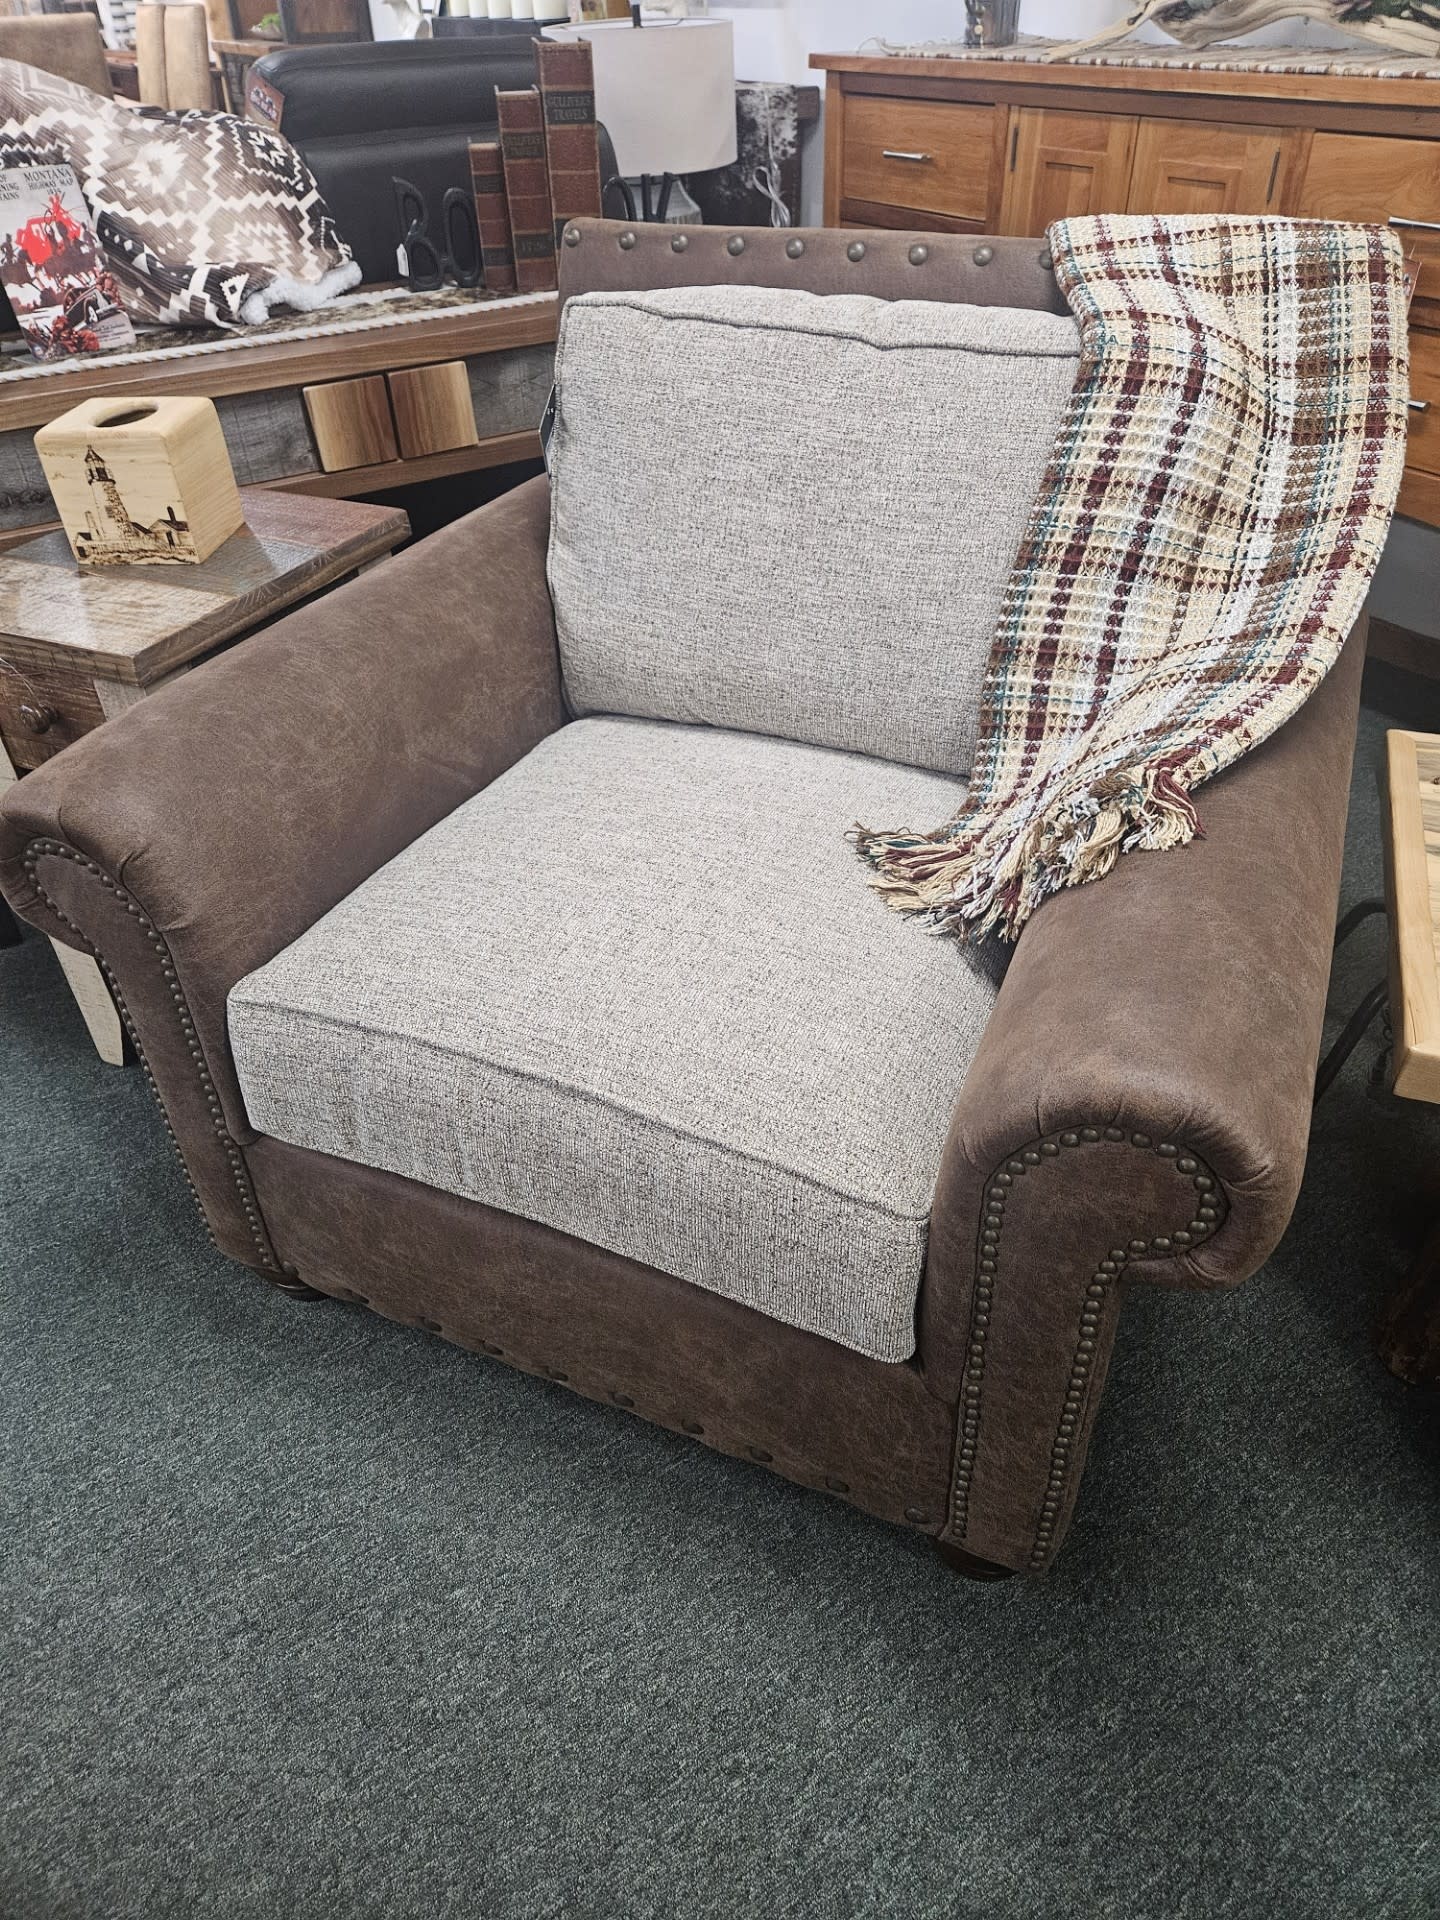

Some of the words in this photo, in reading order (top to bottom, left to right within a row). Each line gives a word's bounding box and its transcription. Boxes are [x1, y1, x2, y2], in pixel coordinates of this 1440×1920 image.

[553, 108, 588, 121] TRAVELS
[23, 168, 72, 182] MONTANA
[28, 180, 57, 191] HIGHWAY
[59, 178, 74, 187] MAP
